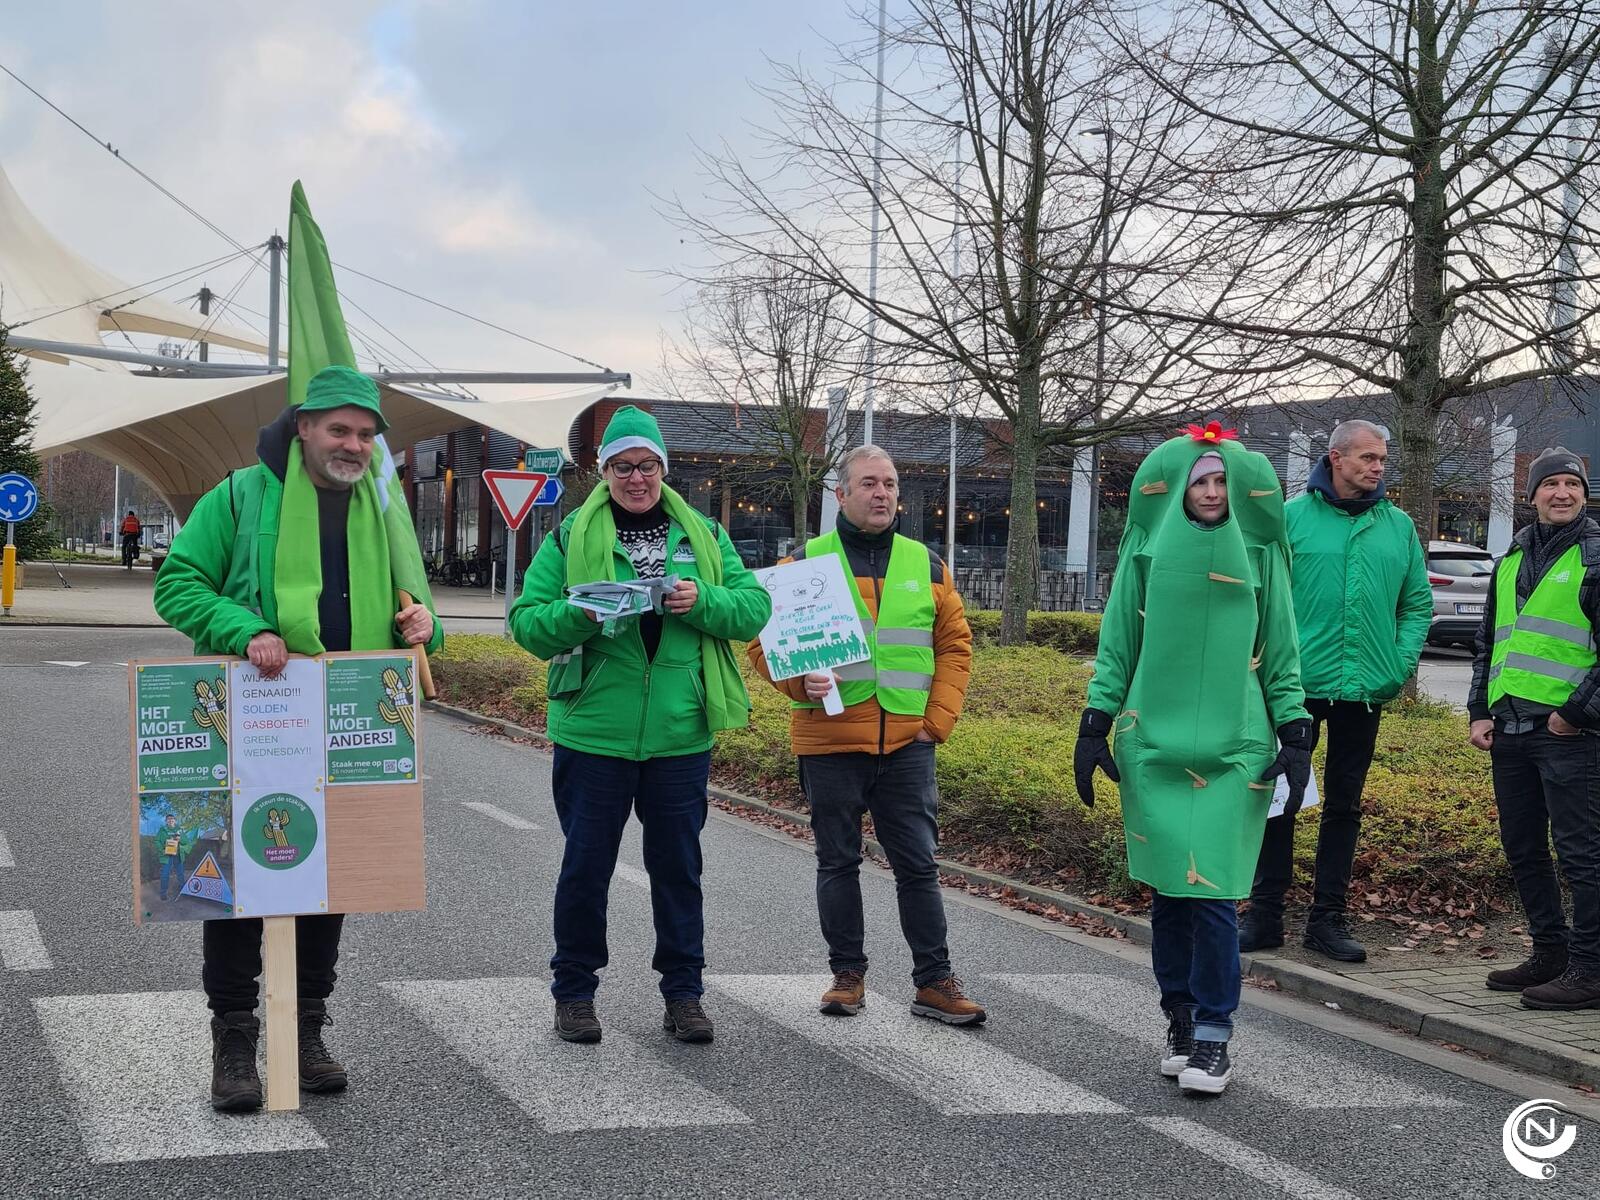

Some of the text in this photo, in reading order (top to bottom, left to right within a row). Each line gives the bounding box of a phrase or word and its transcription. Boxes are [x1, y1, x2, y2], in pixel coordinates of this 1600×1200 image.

[532, 453, 557, 472] Antwerpen
[241, 672, 287, 682] WIJ ZJN
[242, 688, 301, 698] GENAAID!!!
[140, 706, 170, 720] HET
[242, 704, 288, 714] SOLDEN
[329, 703, 358, 716] HET
[141, 721, 186, 735] MOET
[243, 718, 310, 730] GASBOETE!!
[330, 718, 373, 731] MOET
[141, 736, 207, 753] ANDERS!
[243, 735, 278, 744] GREEN
[329, 732, 393, 748] ANDERS!
[243, 746, 312, 757] WEDNESDAY!!
[143, 767, 159, 777] Wij
[161, 766, 194, 775] staken
[196, 766, 209, 775] op
[260, 798, 276, 809] steun
[286, 797, 306, 811] staking
